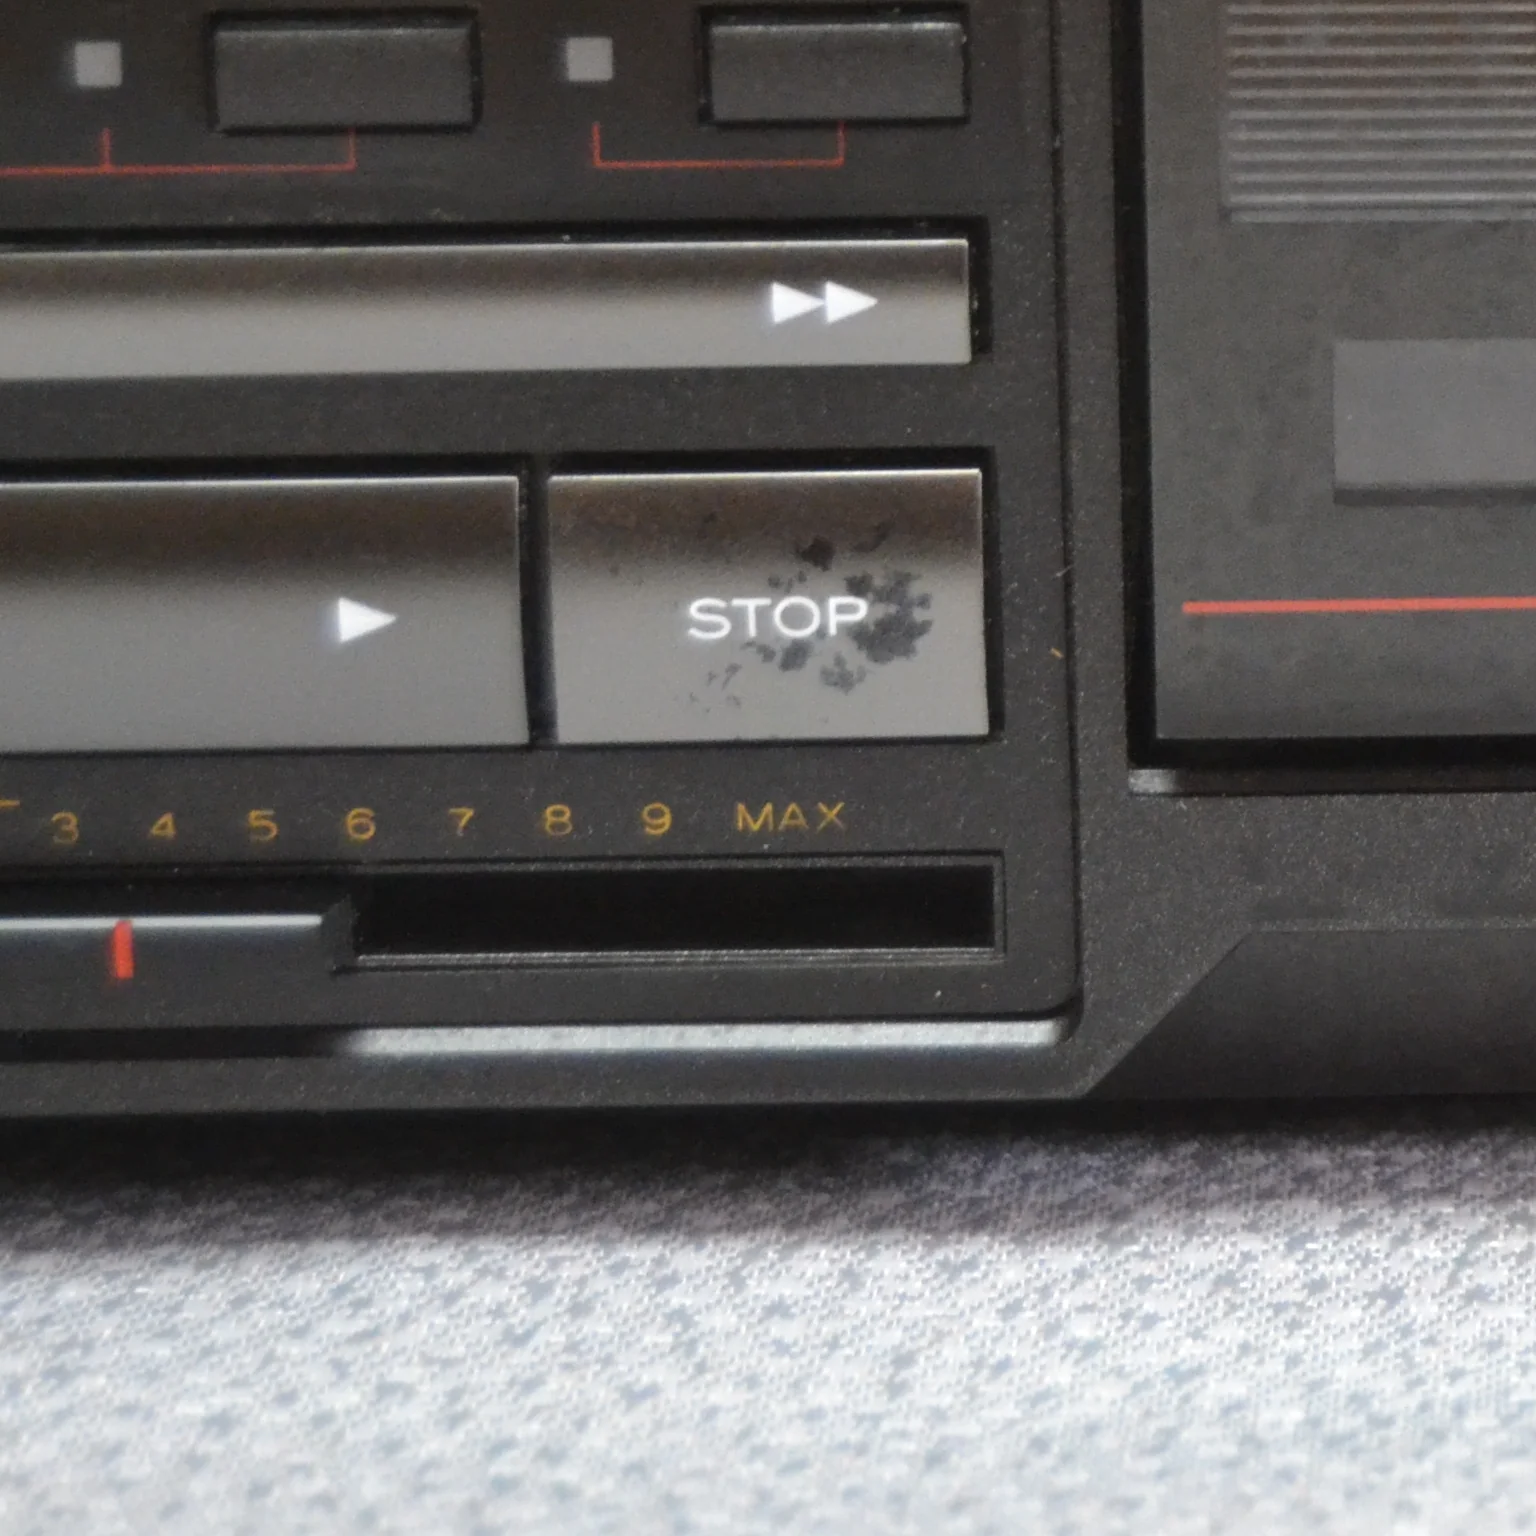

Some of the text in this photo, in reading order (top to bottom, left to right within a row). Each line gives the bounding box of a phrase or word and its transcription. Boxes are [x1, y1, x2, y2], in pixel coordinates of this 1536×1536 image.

[686, 595, 870, 640] STOP
[51, 800, 846, 844] 3 4 5 6 7 8 9 MAX
